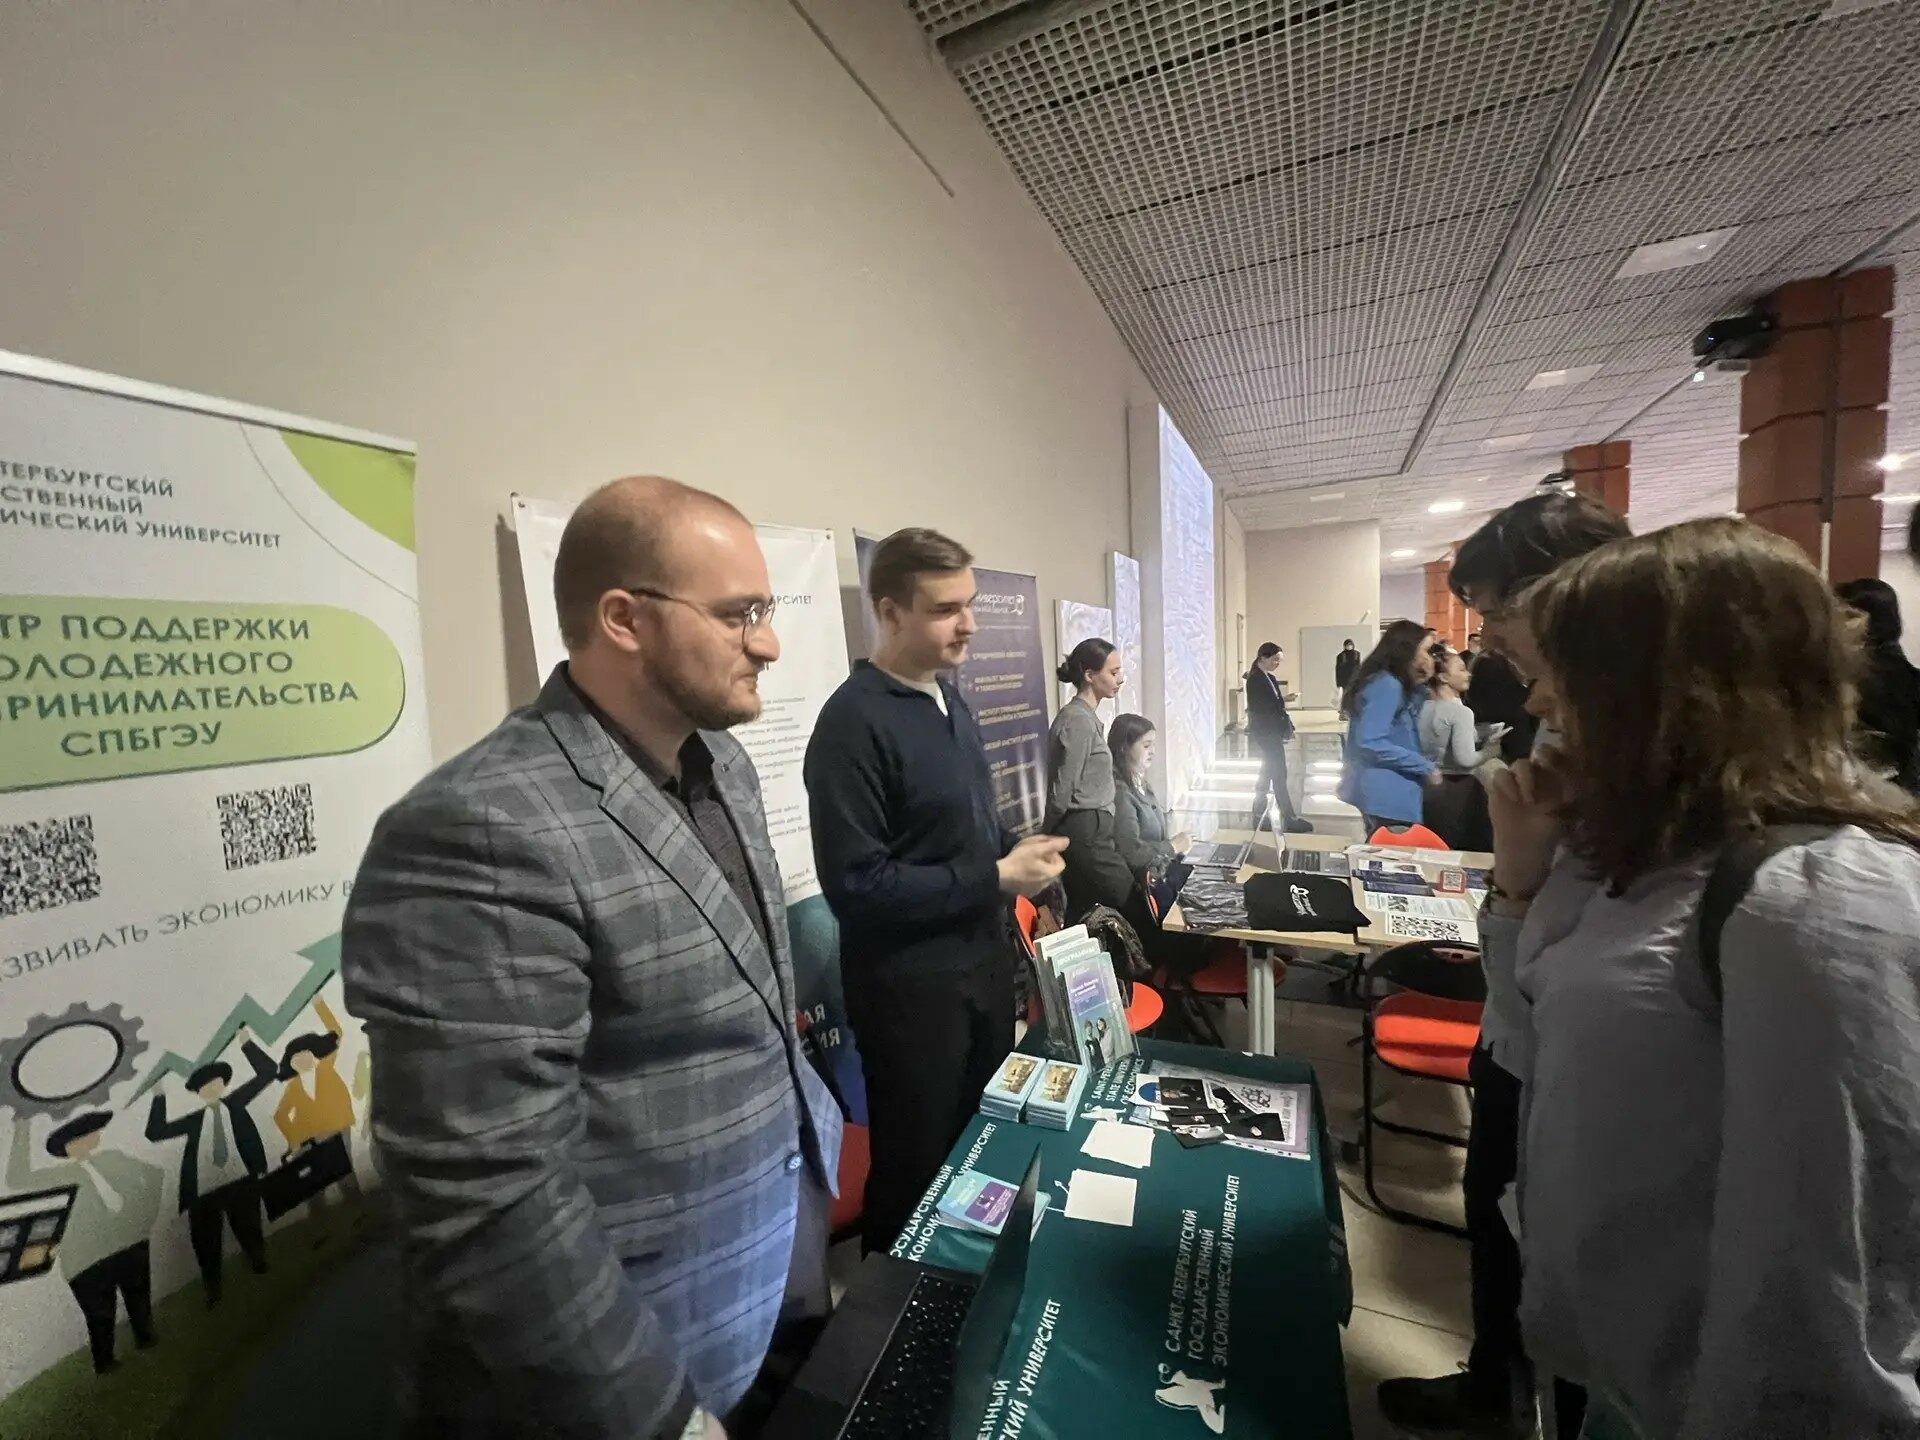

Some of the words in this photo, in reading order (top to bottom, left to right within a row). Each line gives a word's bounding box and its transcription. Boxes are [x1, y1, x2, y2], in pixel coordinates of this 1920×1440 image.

[0, 486, 143, 514] СТВЕННЫЙ
[0, 508, 128, 534] ИЧЕСКИЙ
[136, 520, 281, 548] УНИВЕРСИТЕТ
[61, 615, 310, 643] ПОДДЕРЖКИ
[0, 681, 359, 721] РИНИМАТЕЛЬСТВА
[61, 721, 222, 757] СПБГЭУ
[0, 924, 148, 982] ЗВИВАТЬ
[157, 882, 335, 935] ЭКОНОМИКУ
[957, 1122, 997, 1178] УНИВЕРСИТЕТ
[1221, 1174, 1240, 1241] УНИВЕРСИТЕТ
[1188, 1228, 1215, 1360] ГОСУДАРСТВЕННЫЙ
[1212, 1241, 1234, 1367] ЭКОНОМИЧЕСКИЙ
[1016, 1298, 1061, 1397] УНИВЕРСИТЕТ
